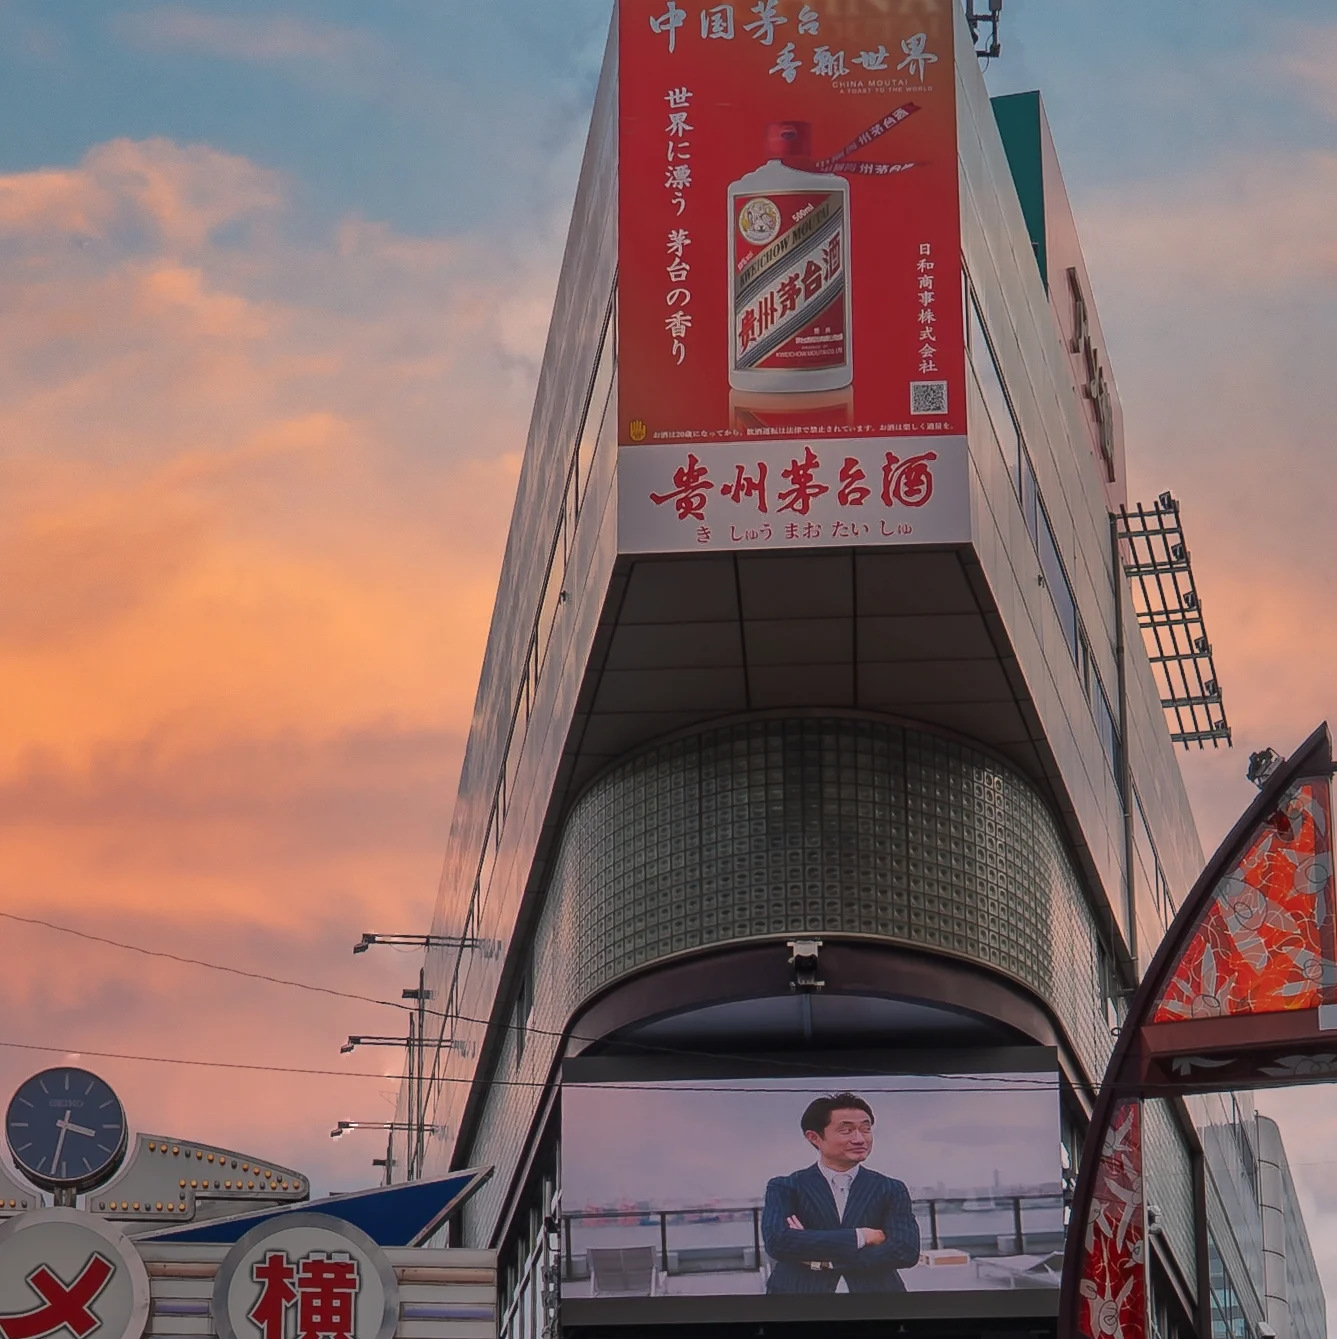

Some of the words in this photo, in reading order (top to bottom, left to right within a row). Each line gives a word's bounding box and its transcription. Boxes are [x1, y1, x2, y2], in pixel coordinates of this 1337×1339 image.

[649, 1, 820, 53] 中国茅台
[832, 80, 864, 88] CHINA
[868, 79, 908, 87] MOUTAI
[664, 86, 695, 217] 世界に漂う
[739, 236, 790, 284] KWEICHOW
[791, 204, 831, 245] MOUTAI
[791, 202, 815, 224] 500ml
[666, 228, 693, 366] 茅台の香り
[917, 243, 938, 374] 日和商事株式会社
